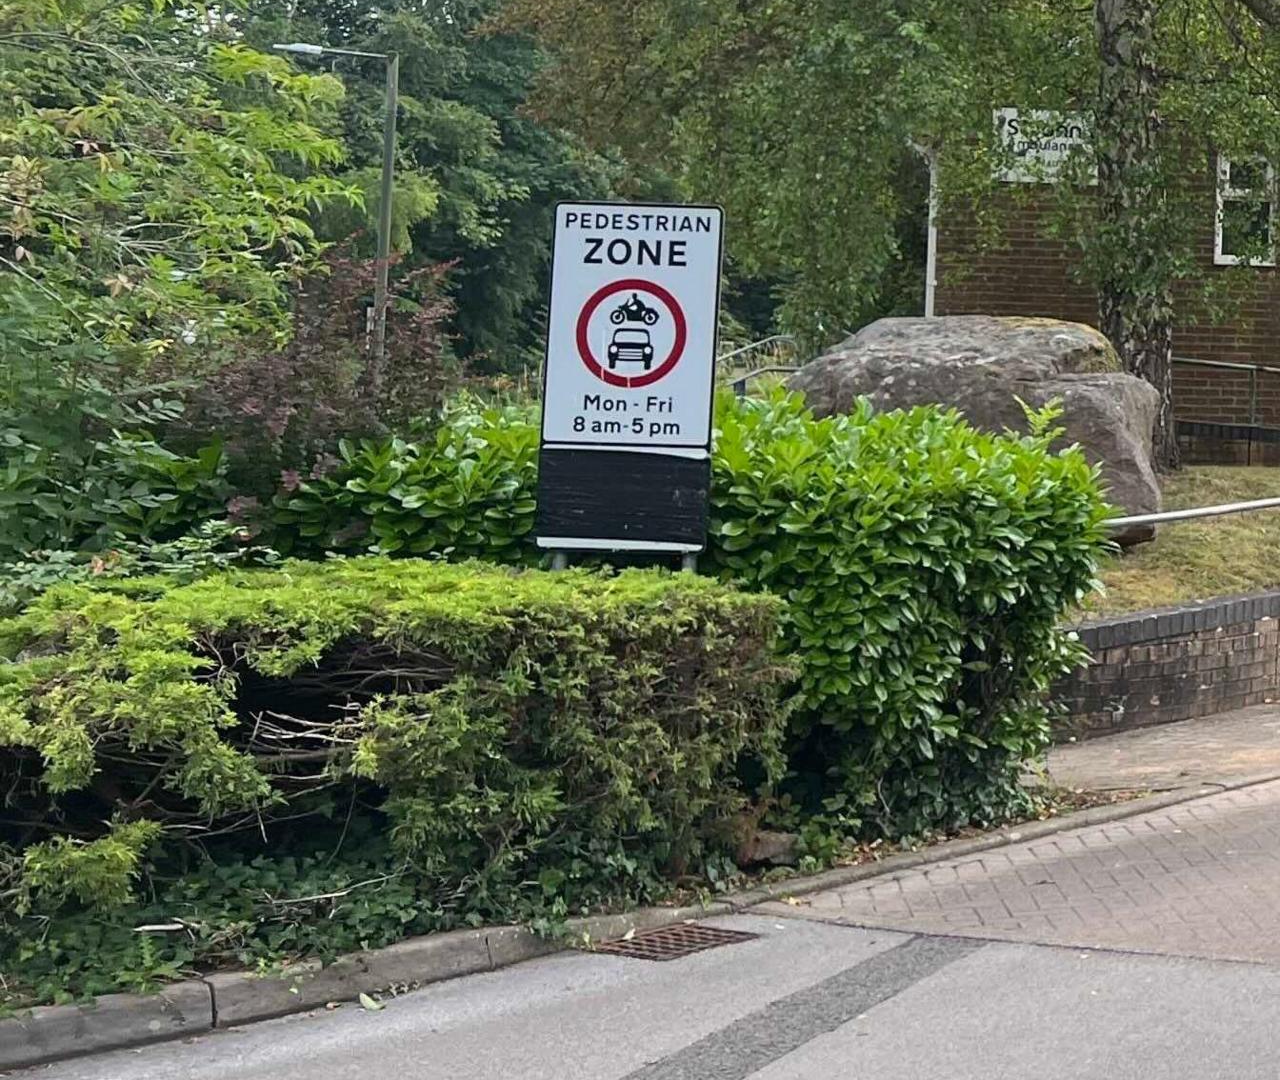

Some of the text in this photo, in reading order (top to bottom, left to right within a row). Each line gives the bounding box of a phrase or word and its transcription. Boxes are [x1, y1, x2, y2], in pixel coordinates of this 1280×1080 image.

[566, 213, 711, 232] PEDESTRIAN
[584, 238, 686, 267] ZONE
[584, 395, 627, 411] Mon
[647, 397, 672, 412] Fri
[573, 417, 584, 432] 8
[650, 420, 680, 437] pm
